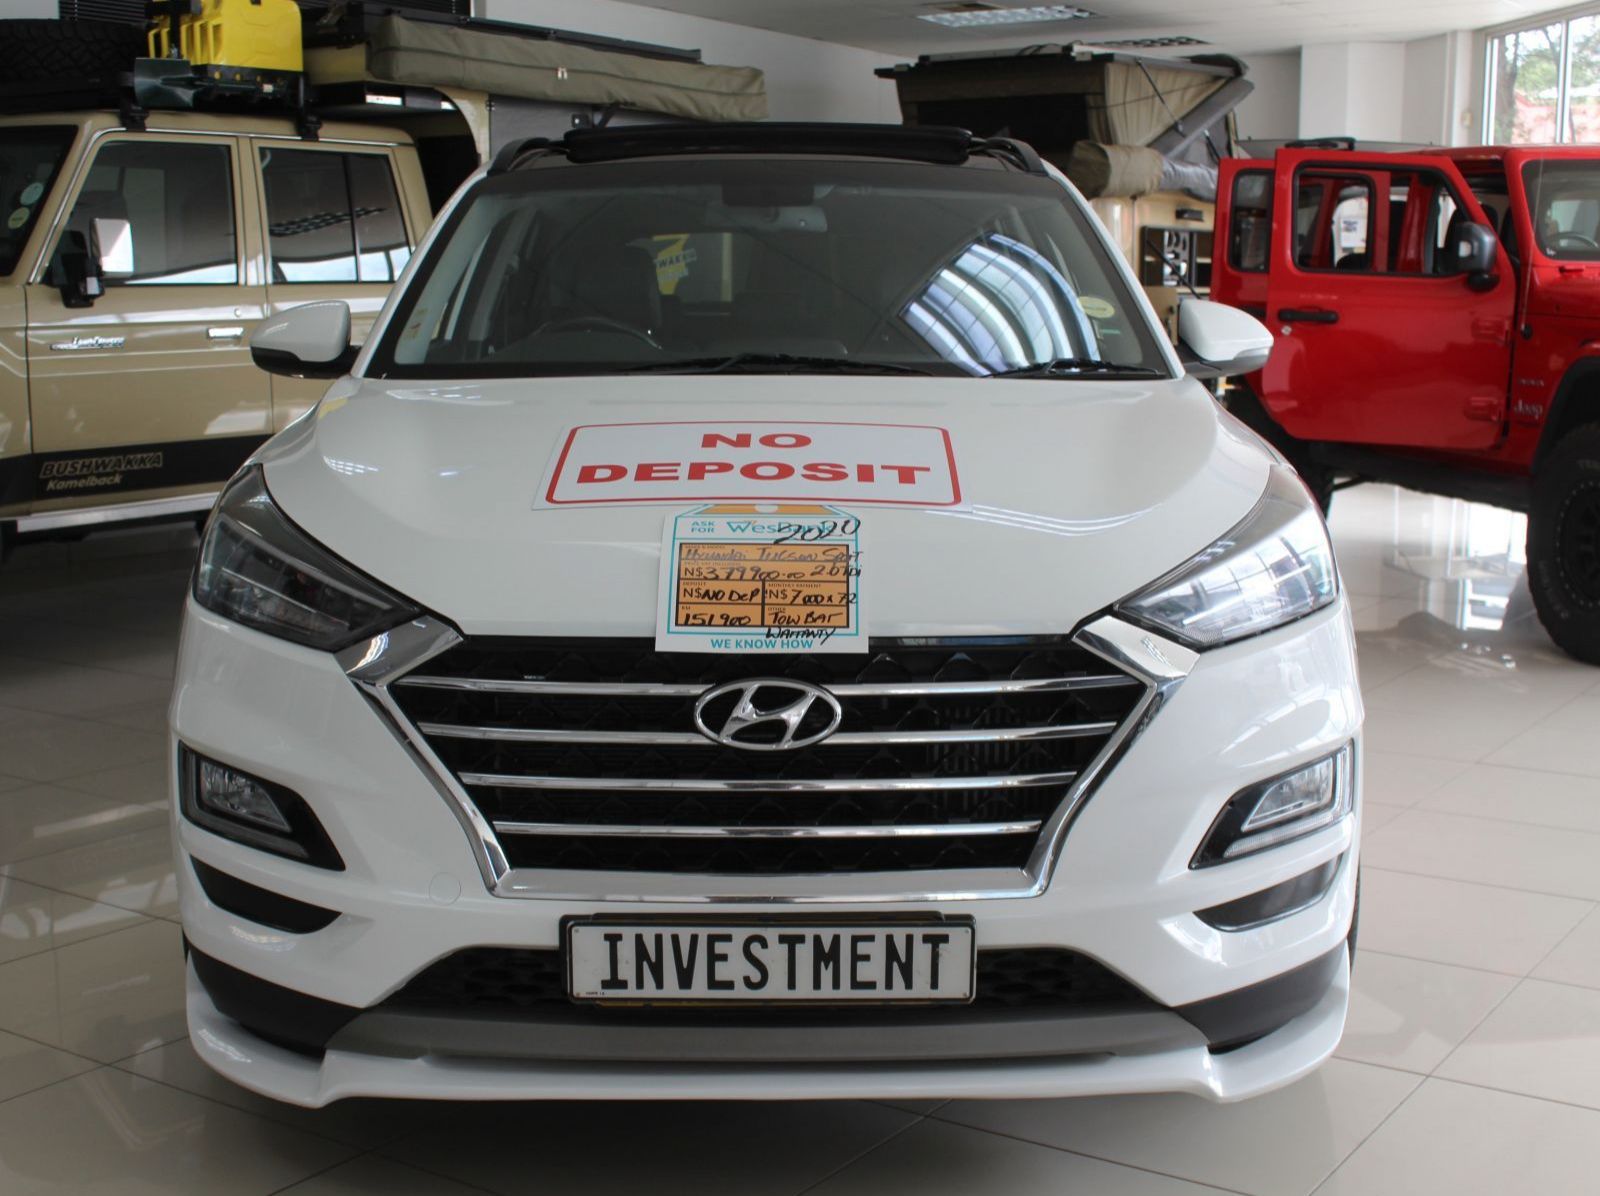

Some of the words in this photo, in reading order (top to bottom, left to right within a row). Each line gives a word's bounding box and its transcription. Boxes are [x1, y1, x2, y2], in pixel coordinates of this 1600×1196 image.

[701, 433, 812, 448] NO
[39, 452, 163, 478] BUSHWAKKA
[576, 462, 931, 485] DEPOSIT
[46, 474, 123, 491] Kamelback
[773, 519, 862, 545] 2020
[711, 639, 731, 649] WE
[735, 639, 777, 649] KNOW
[781, 639, 814, 649] HOW
[600, 933, 950, 991] INVESTMENT
